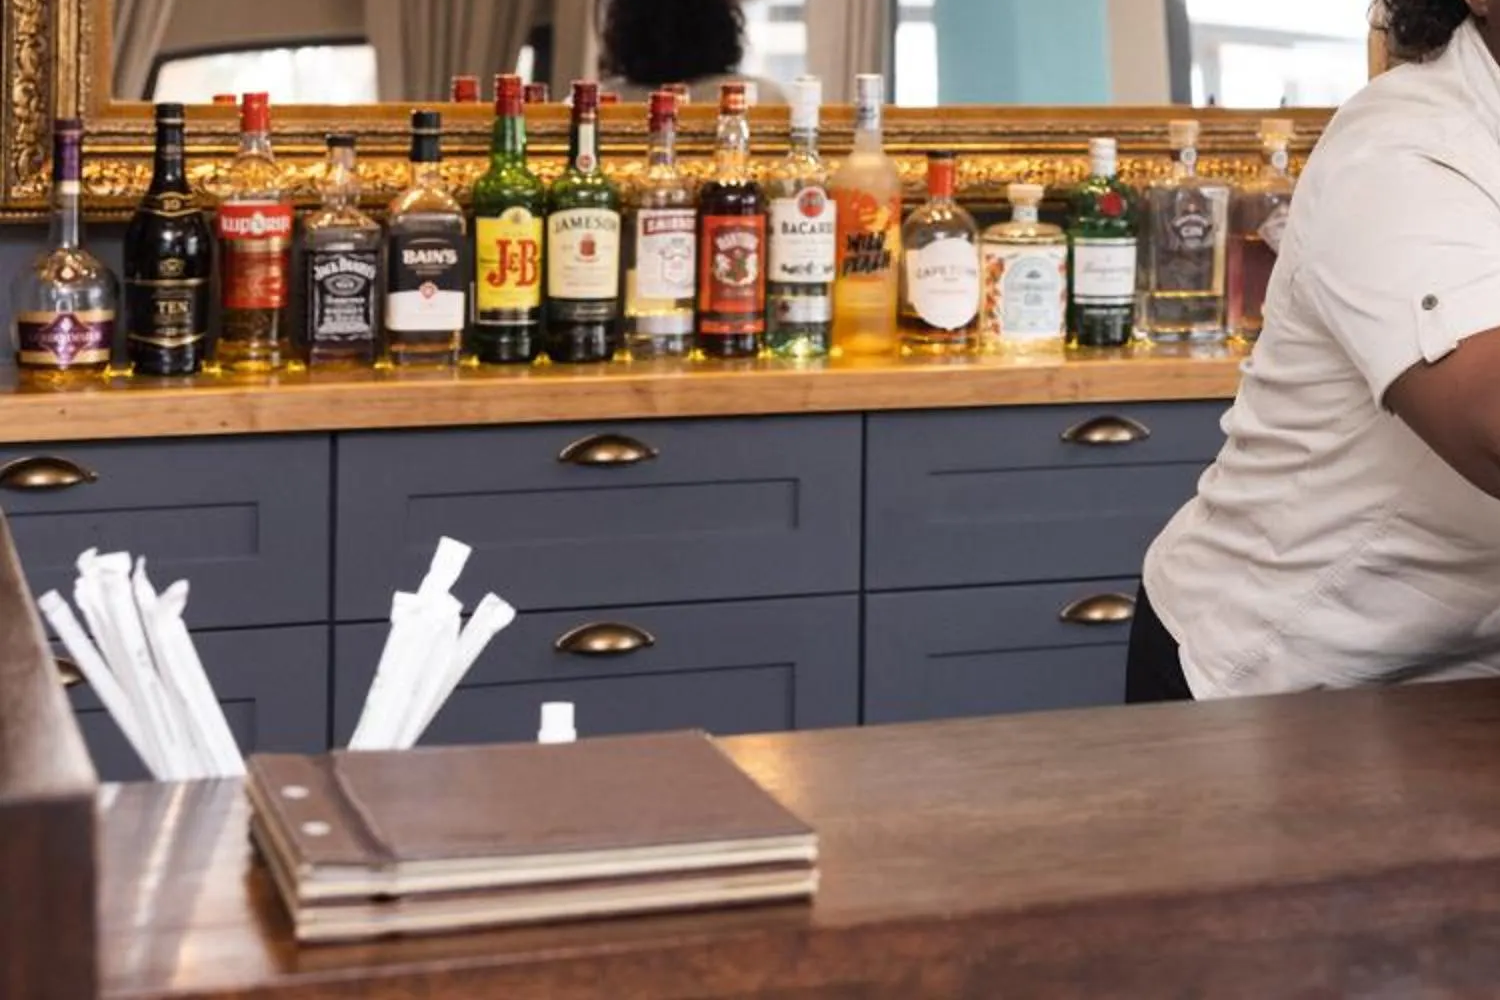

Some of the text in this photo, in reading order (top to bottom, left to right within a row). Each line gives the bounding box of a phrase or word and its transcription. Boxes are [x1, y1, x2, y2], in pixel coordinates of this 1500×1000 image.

[781, 221, 833, 235] BACARD
[486, 238, 539, 288] J&B
[157, 301, 190, 315] TEN
